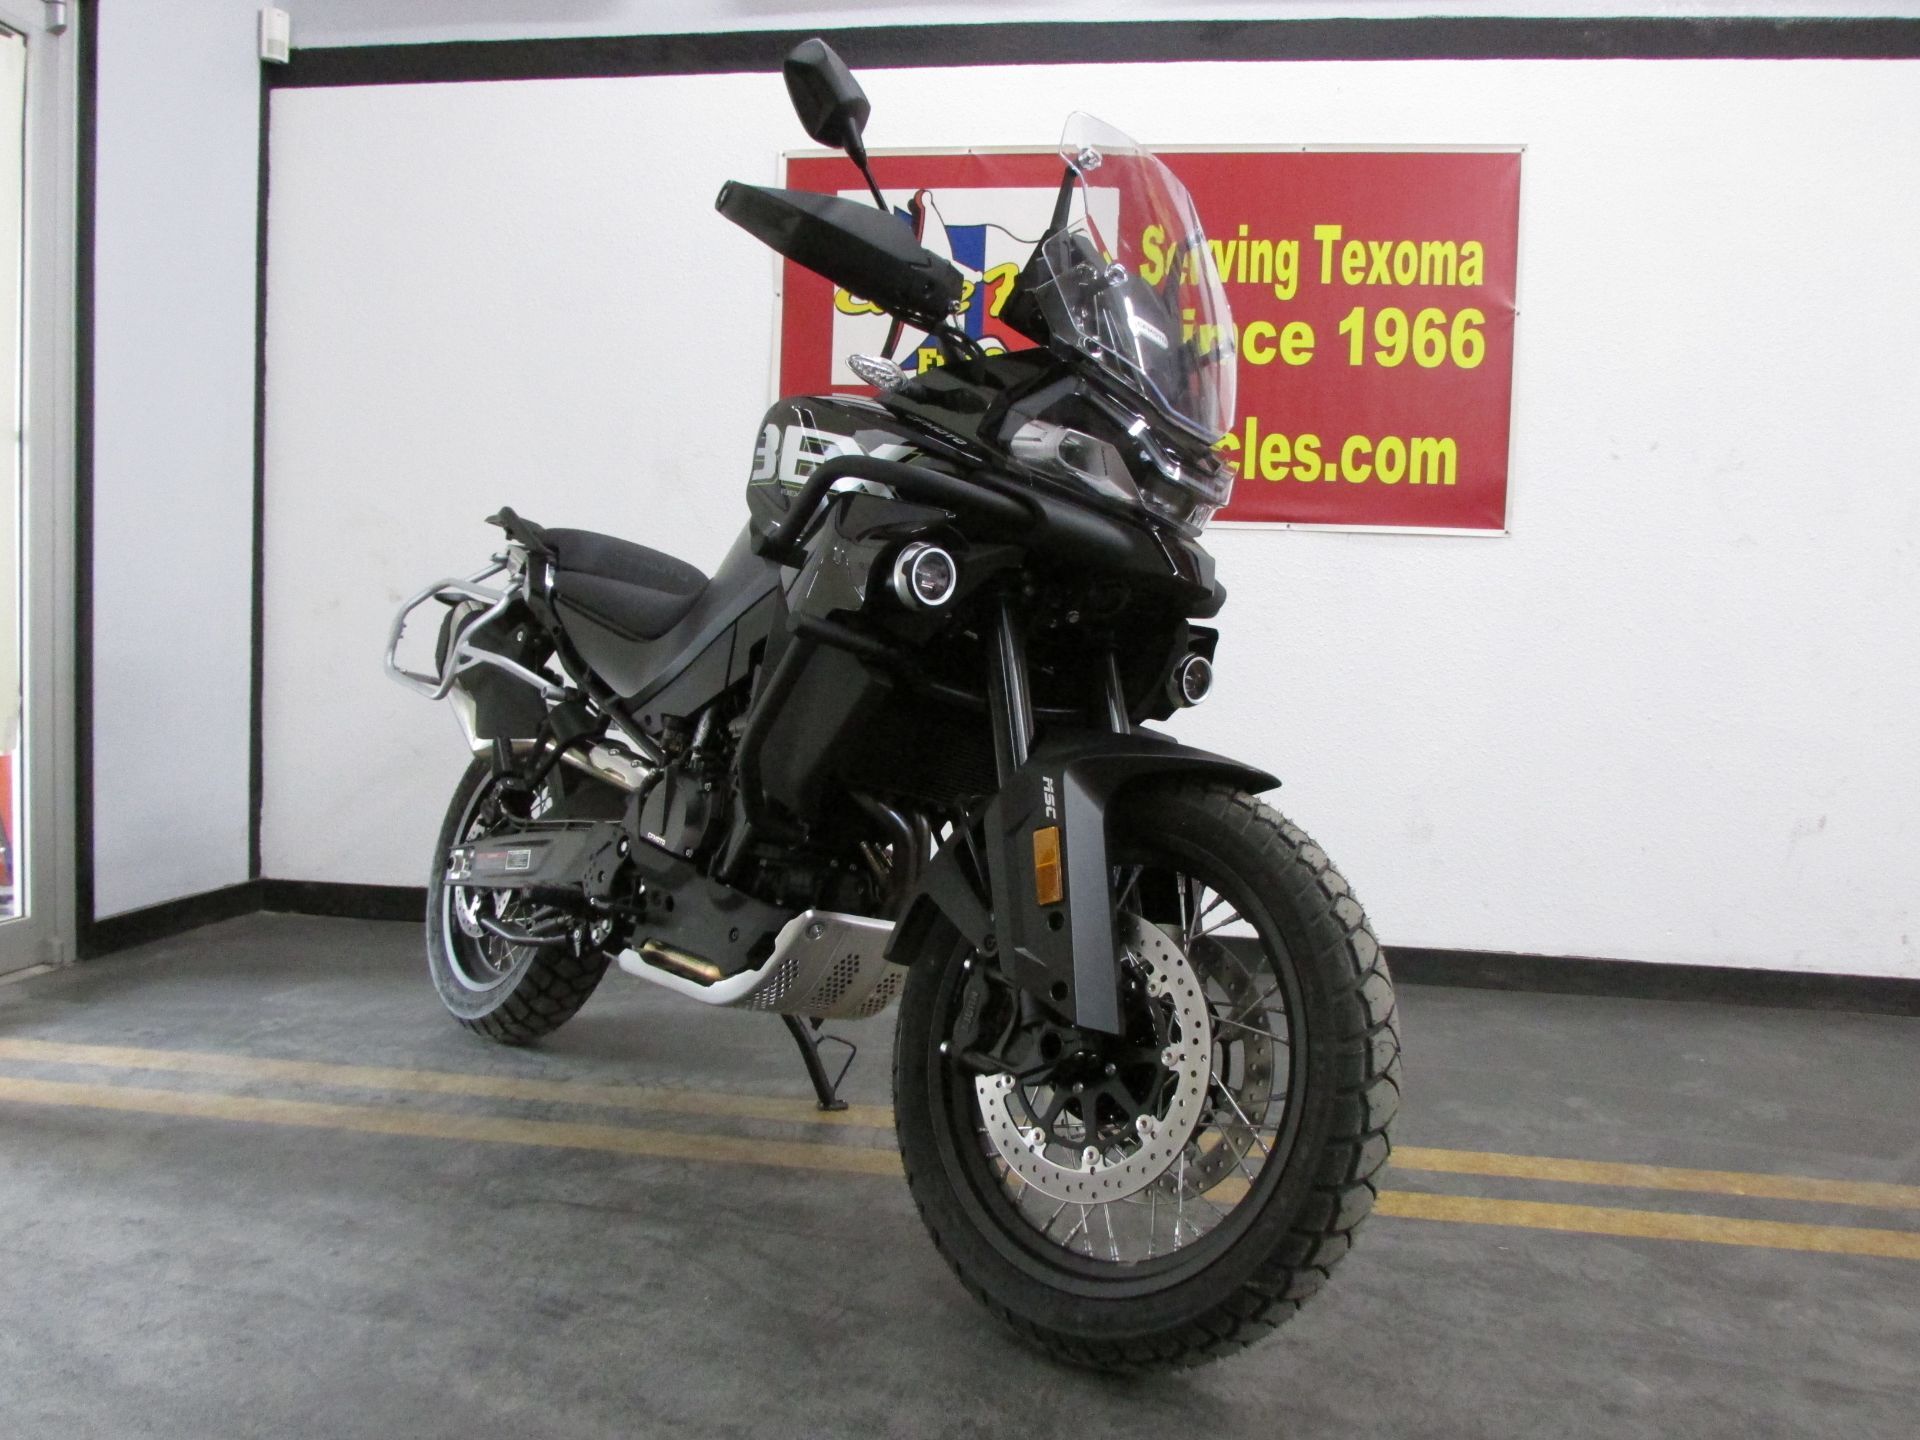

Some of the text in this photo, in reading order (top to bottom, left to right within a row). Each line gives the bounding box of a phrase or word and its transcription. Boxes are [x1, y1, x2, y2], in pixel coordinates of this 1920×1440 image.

[1313, 224, 1485, 286] Texoma
[1338, 306, 1486, 369] 1966
[1042, 775, 1057, 820] MSC
